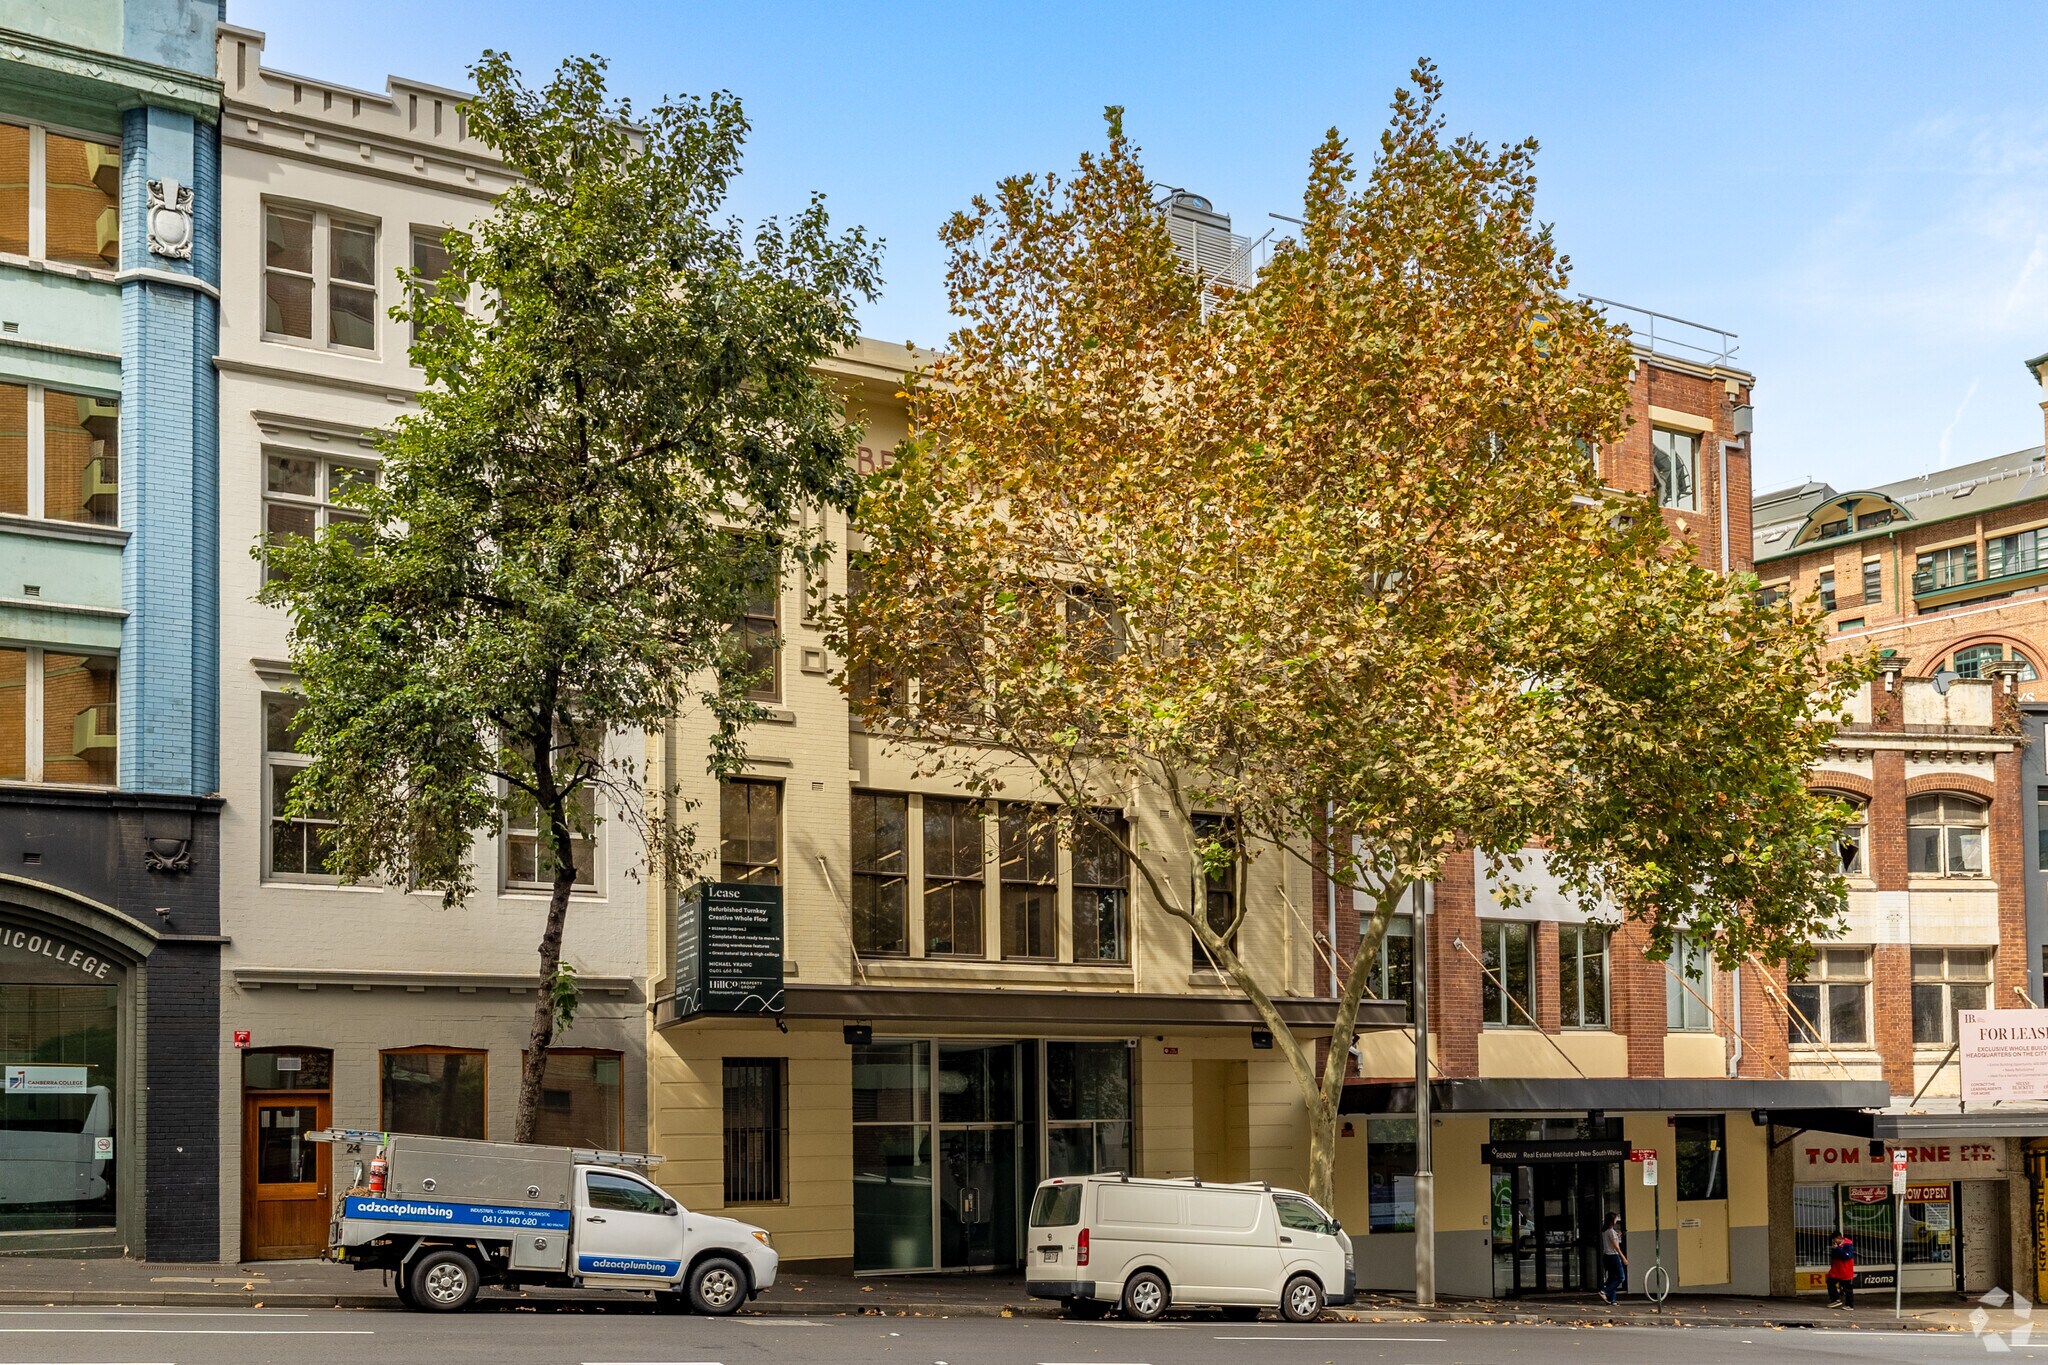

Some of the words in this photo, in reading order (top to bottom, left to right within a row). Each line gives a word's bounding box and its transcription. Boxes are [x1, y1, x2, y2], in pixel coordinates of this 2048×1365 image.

[709, 887, 740, 898] Lease
[0, 927, 111, 979] ICOLLEGE
[709, 981, 738, 989] HillCo
[1980, 1028, 2007, 1040] FOR
[346, 1144, 360, 1153] 24
[1806, 1148, 1859, 1164] TOM
[1923, 1188, 1947, 1199] OPEN
[358, 1202, 453, 1219] adzactplumbing
[482, 1215, 503, 1223] 0416
[593, 1259, 666, 1273] adzactplumbing
[1864, 1275, 1893, 1284] rizoma
